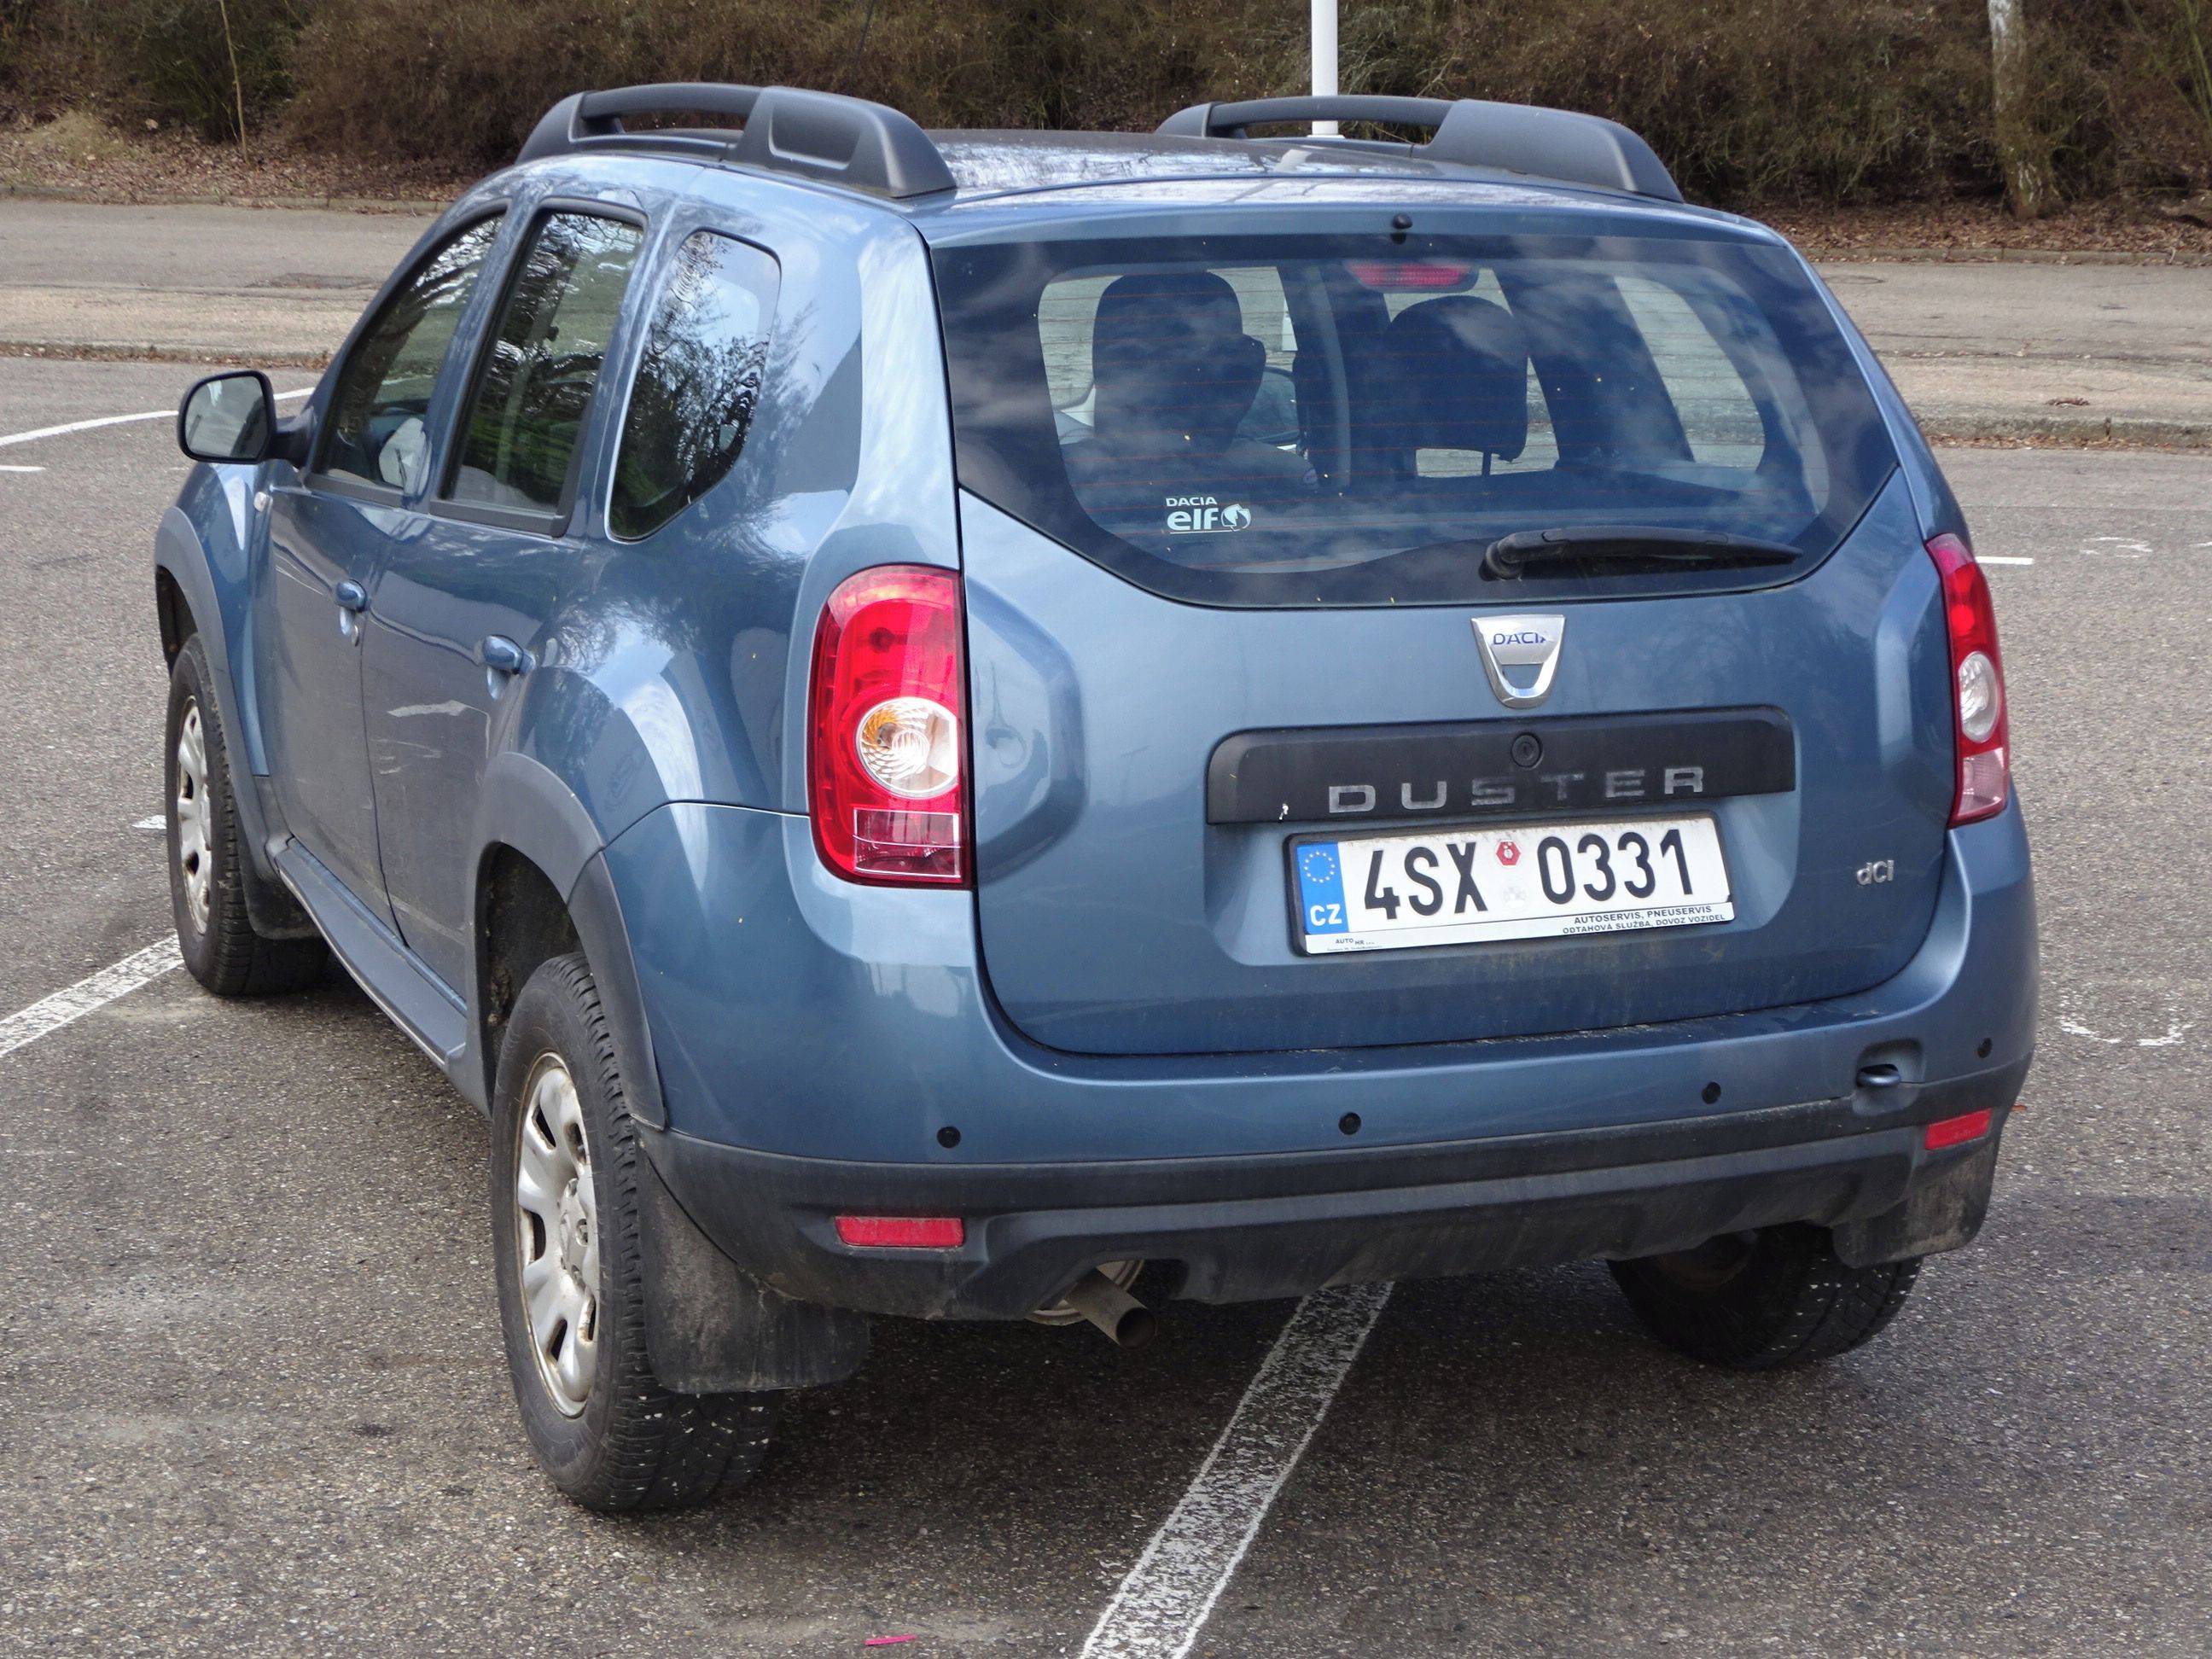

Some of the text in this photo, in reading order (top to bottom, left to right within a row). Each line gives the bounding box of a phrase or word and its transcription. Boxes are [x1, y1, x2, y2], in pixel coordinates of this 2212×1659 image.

[1166, 497, 1218, 507] DACIA
[1167, 507, 1220, 531] elf
[1329, 767, 1704, 813] DUSTER
[1365, 829, 1693, 920] 4SX 0331
[1310, 904, 1342, 926] CZ
[1574, 905, 1712, 924] AUTOSERVIS, PNEUSERVIS
[1656, 917, 1687, 926] DOVOZ
[1689, 914, 1726, 923] VOZIDEL
